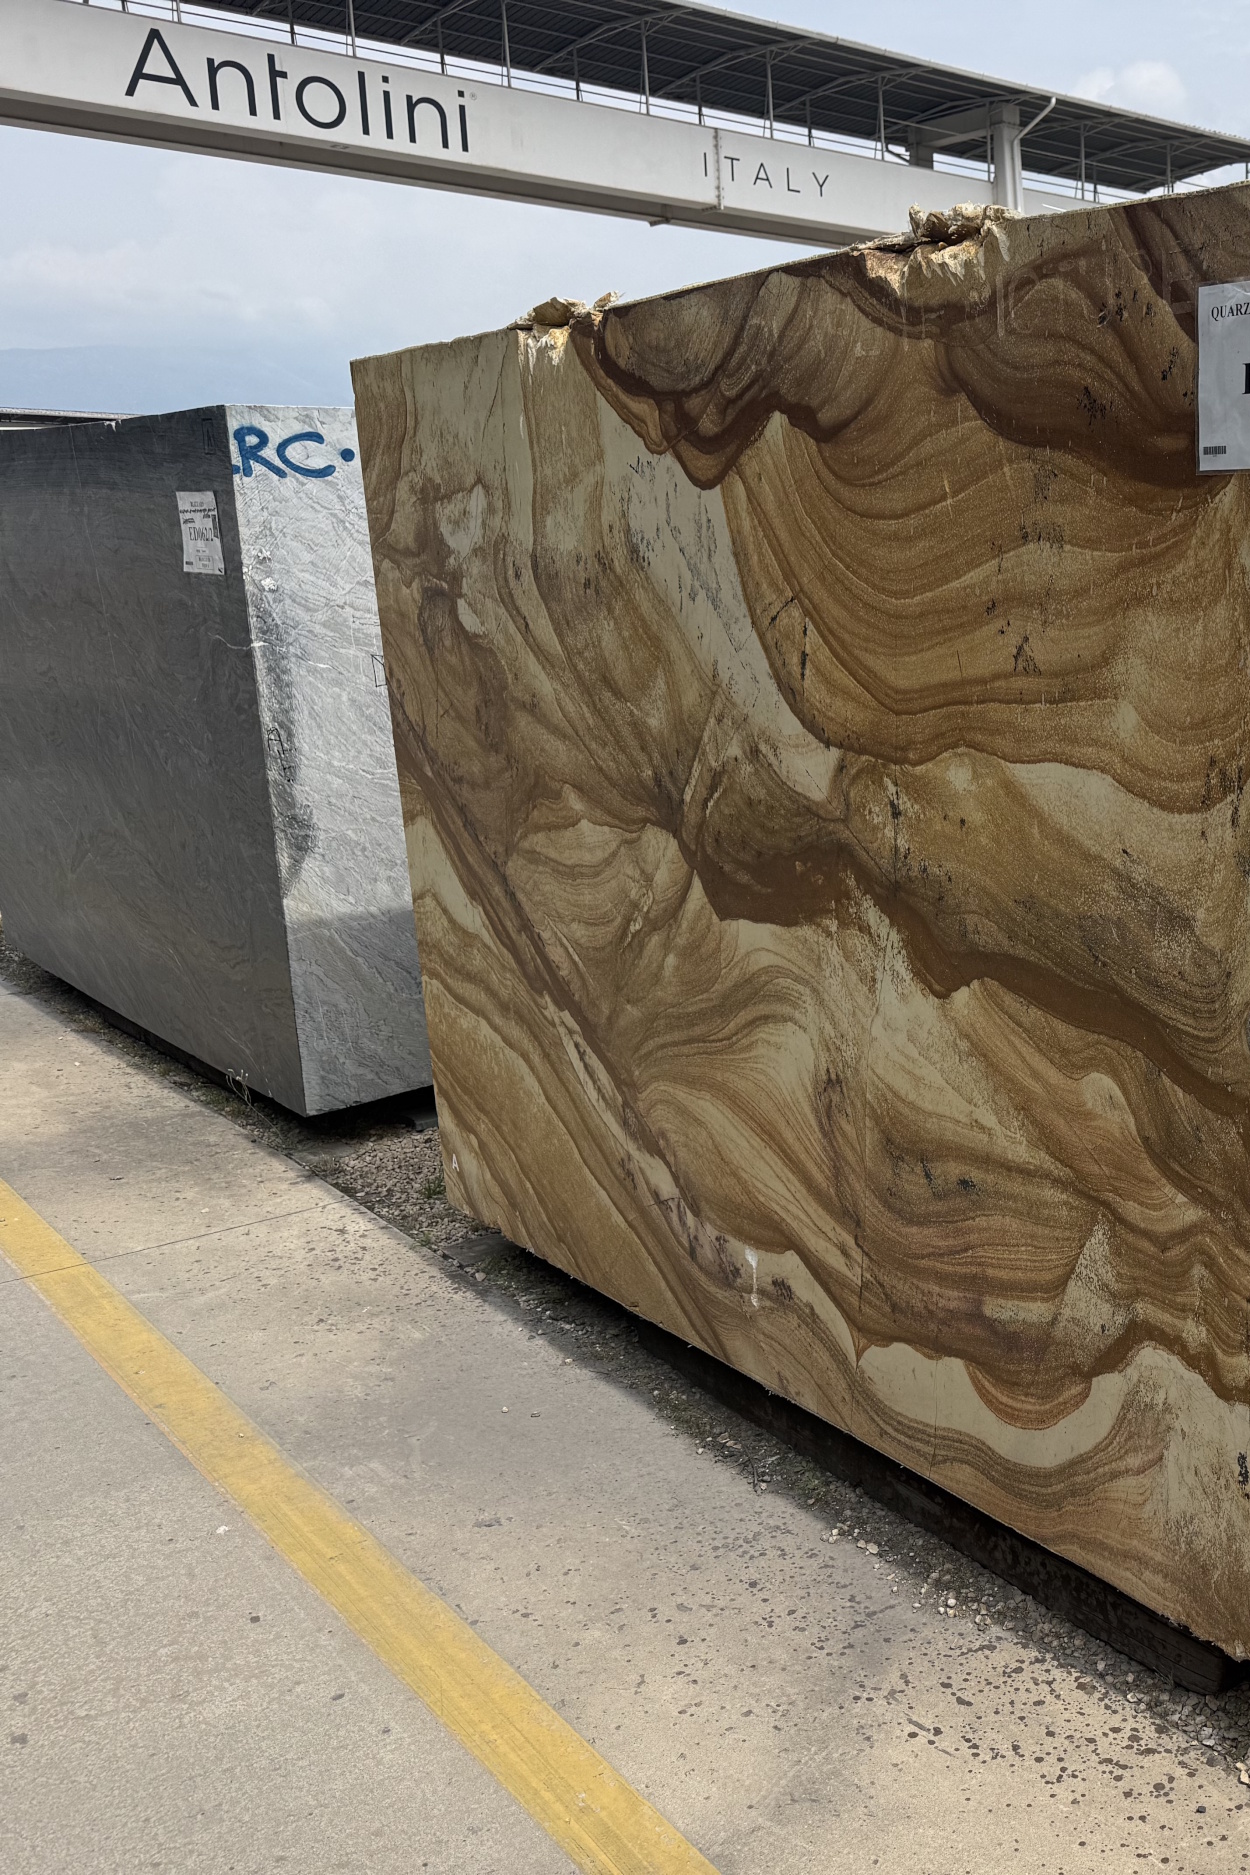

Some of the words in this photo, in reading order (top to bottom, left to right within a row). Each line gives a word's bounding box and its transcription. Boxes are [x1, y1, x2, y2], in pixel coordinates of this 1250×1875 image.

[125, 28, 470, 153] Antolini
[704, 152, 831, 198] ITALY
[452, 1153, 460, 1172] A
